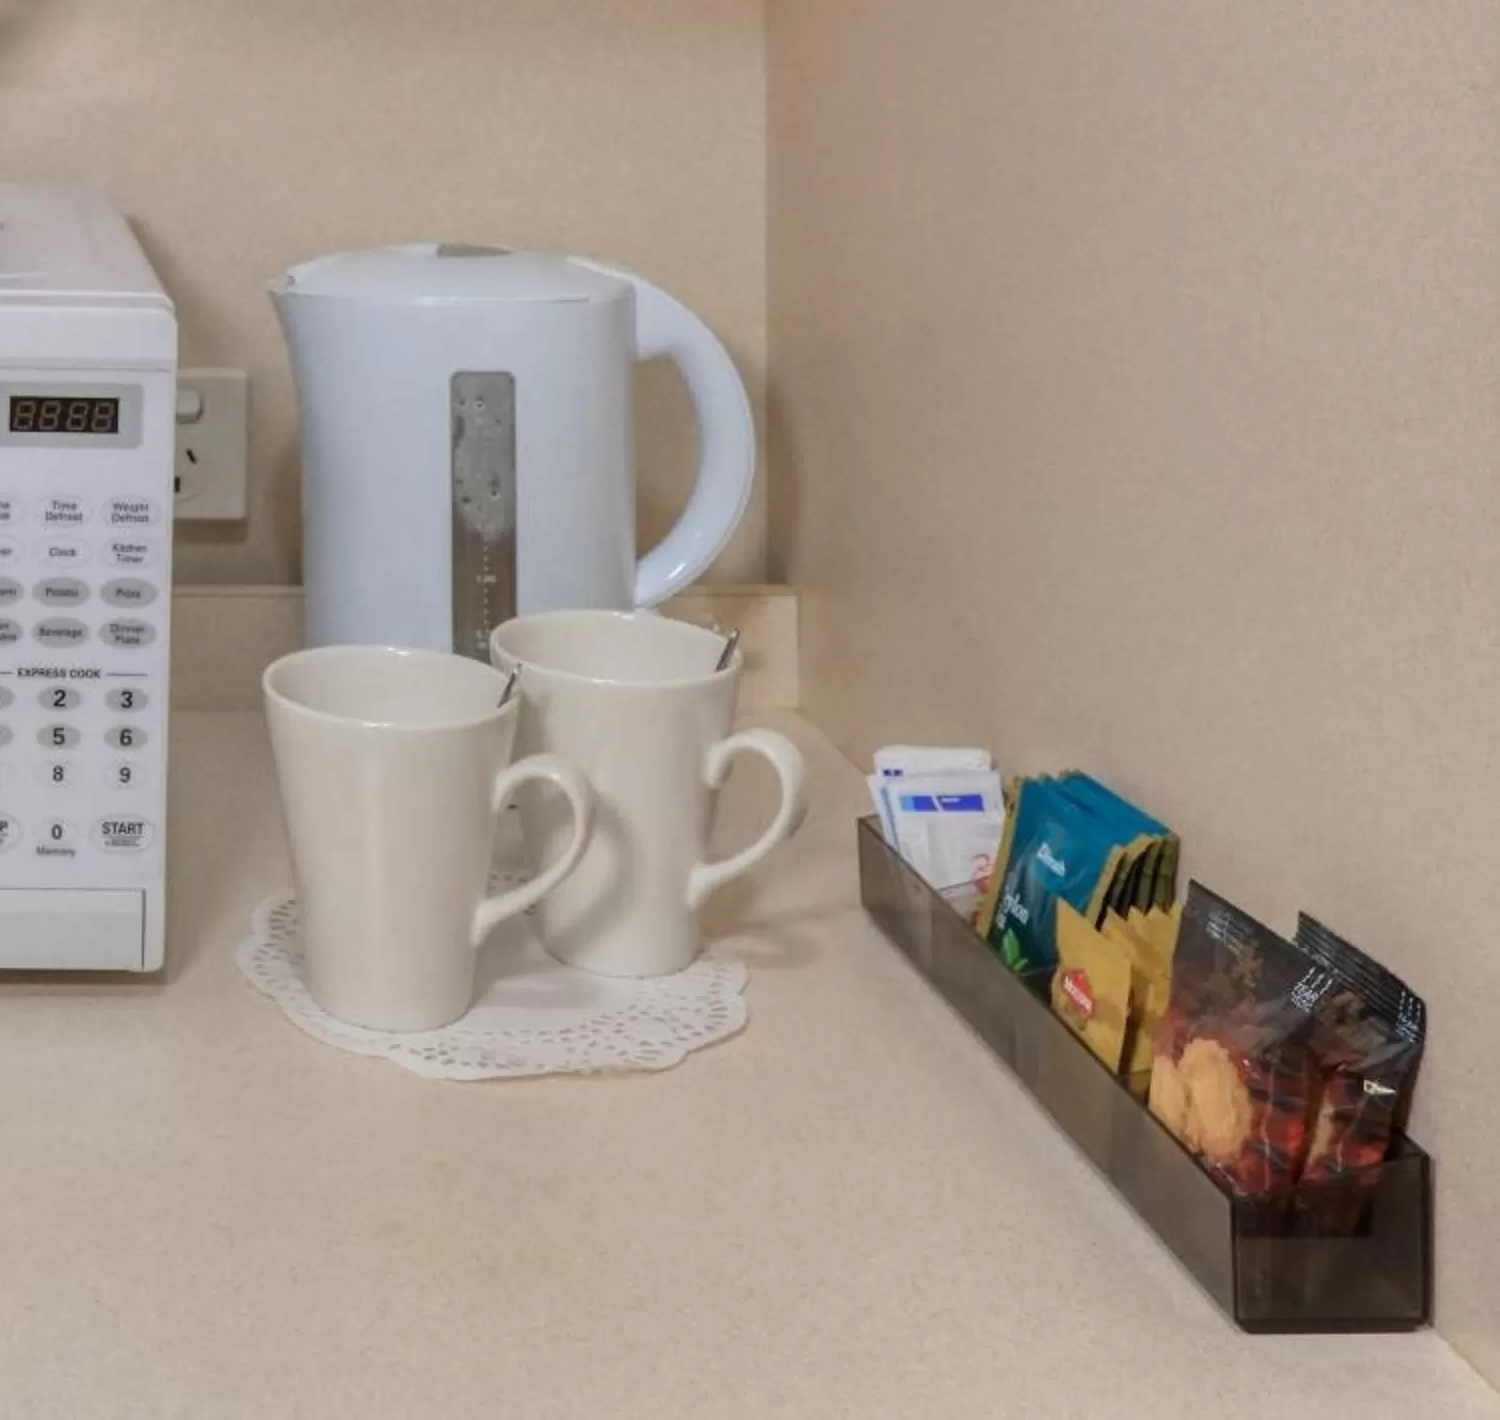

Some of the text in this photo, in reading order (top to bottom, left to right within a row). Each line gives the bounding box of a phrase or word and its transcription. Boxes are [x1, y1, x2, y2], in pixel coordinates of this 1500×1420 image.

[52, 500, 77, 511] Time
[113, 502, 149, 513] Weight
[45, 511, 83, 522] Defrost
[111, 513, 149, 523] Defrost
[49, 547, 77, 557] Clock
[17, 668, 102, 679] EXPRESS COOK
[53, 689, 67, 708] 2
[120, 691, 133, 709] 3
[53, 727, 65, 746] 5
[119, 728, 133, 747] 6
[53, 765, 64, 782] 8
[119, 767, 131, 783] 9
[51, 824, 63, 840] 0
[101, 821, 144, 835] START
